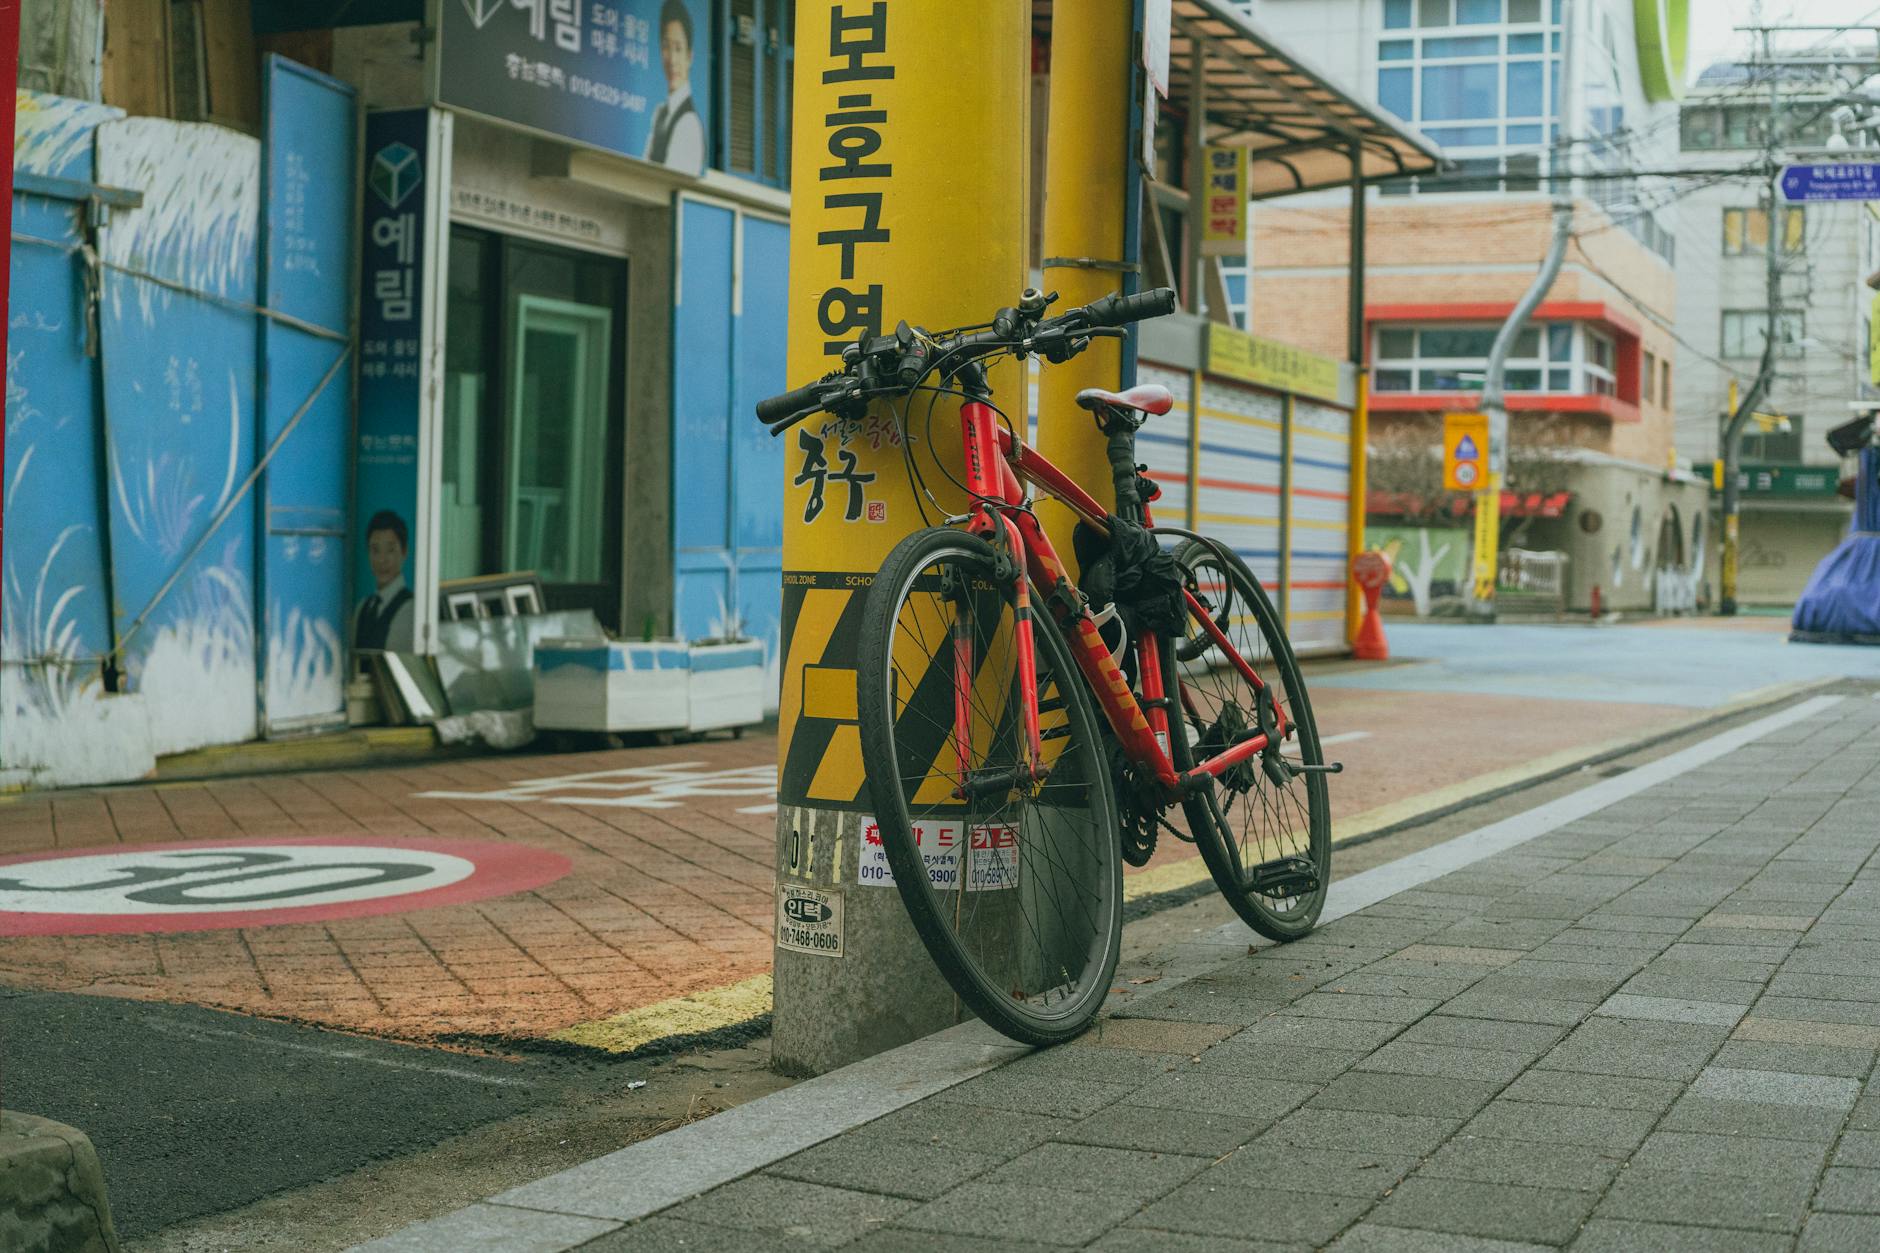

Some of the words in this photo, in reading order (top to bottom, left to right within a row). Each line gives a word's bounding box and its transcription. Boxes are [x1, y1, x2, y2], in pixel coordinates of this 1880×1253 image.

[817, 2, 895, 356] 보호구역
[373, 213, 415, 320] 예림
[795, 429, 875, 522] 중구
[967, 418, 983, 481] ALTON
[799, 575, 816, 585] ZONE
[845, 576, 876, 586] SCHO
[787, 900, 822, 922] 인력
